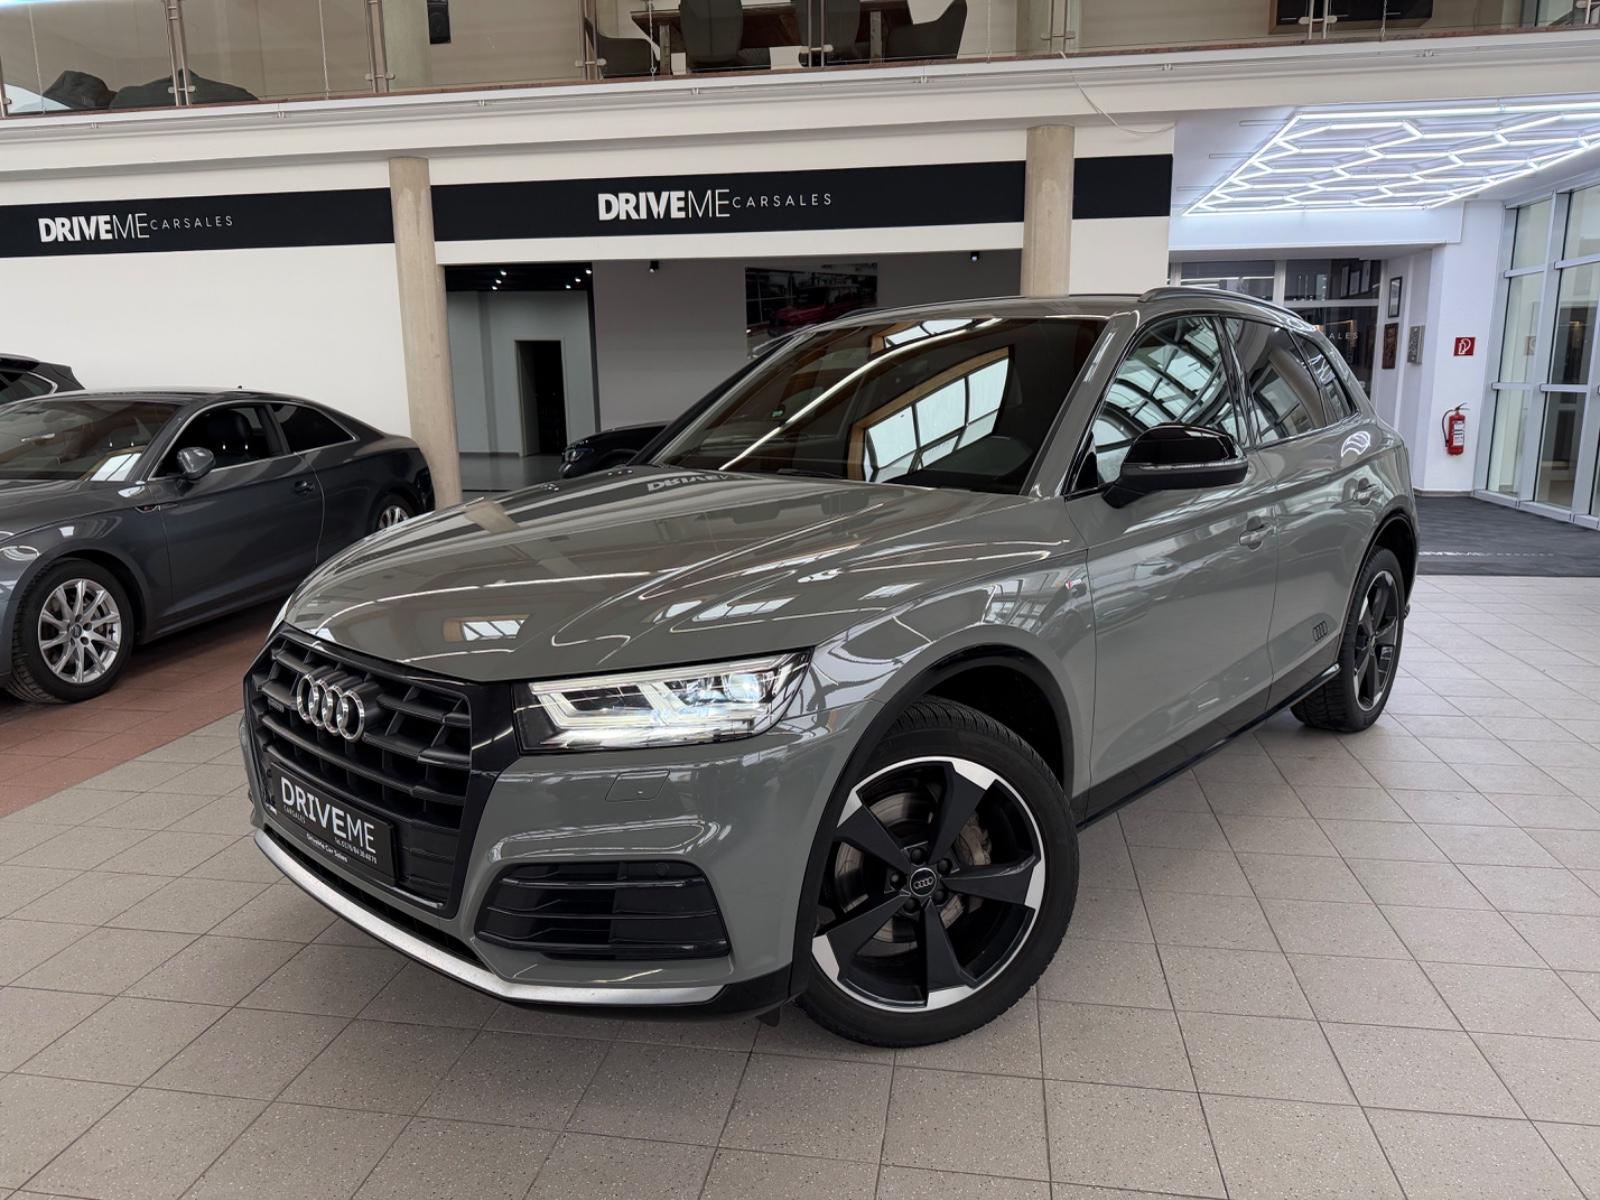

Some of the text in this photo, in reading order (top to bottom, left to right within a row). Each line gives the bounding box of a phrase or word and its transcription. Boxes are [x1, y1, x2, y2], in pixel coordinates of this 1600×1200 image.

[597, 189, 833, 221] DRIVEME CARSALES
[37, 213, 234, 243] DRIVEME CARSALES
[280, 776, 377, 854] DRIVEME
